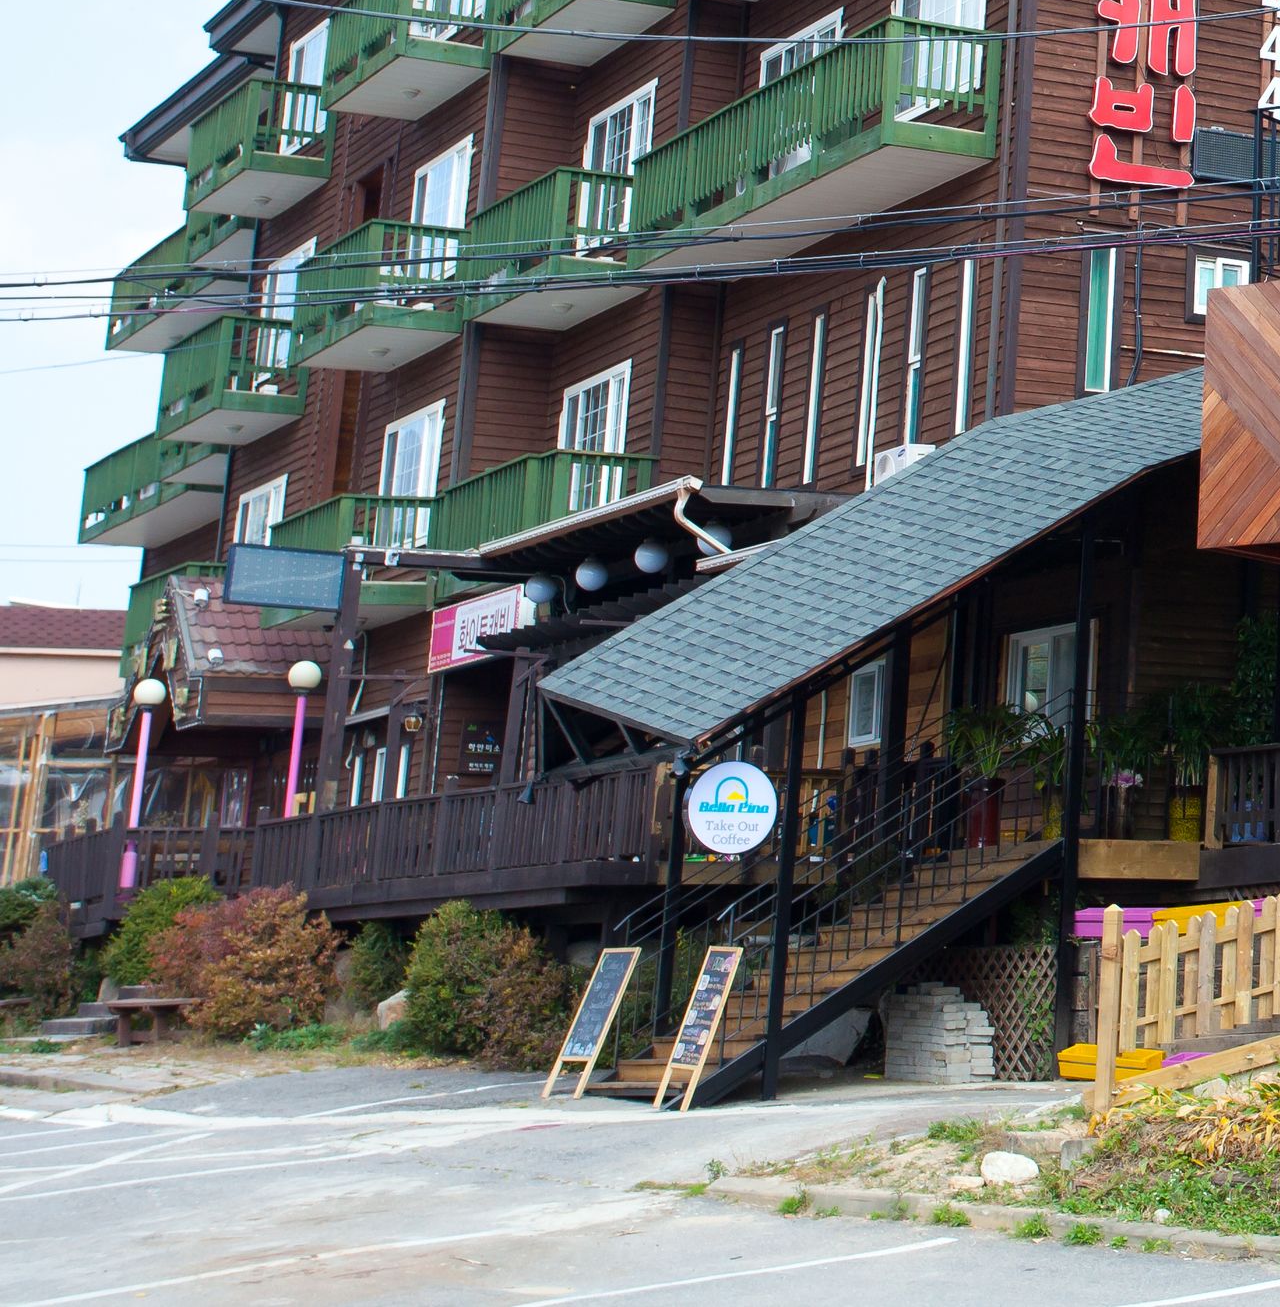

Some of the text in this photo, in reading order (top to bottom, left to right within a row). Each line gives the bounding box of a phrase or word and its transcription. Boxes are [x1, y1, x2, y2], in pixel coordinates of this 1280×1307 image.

[699, 801, 735, 813] Bella
[705, 819, 759, 832] Take Out
[711, 833, 751, 845] Coffee
